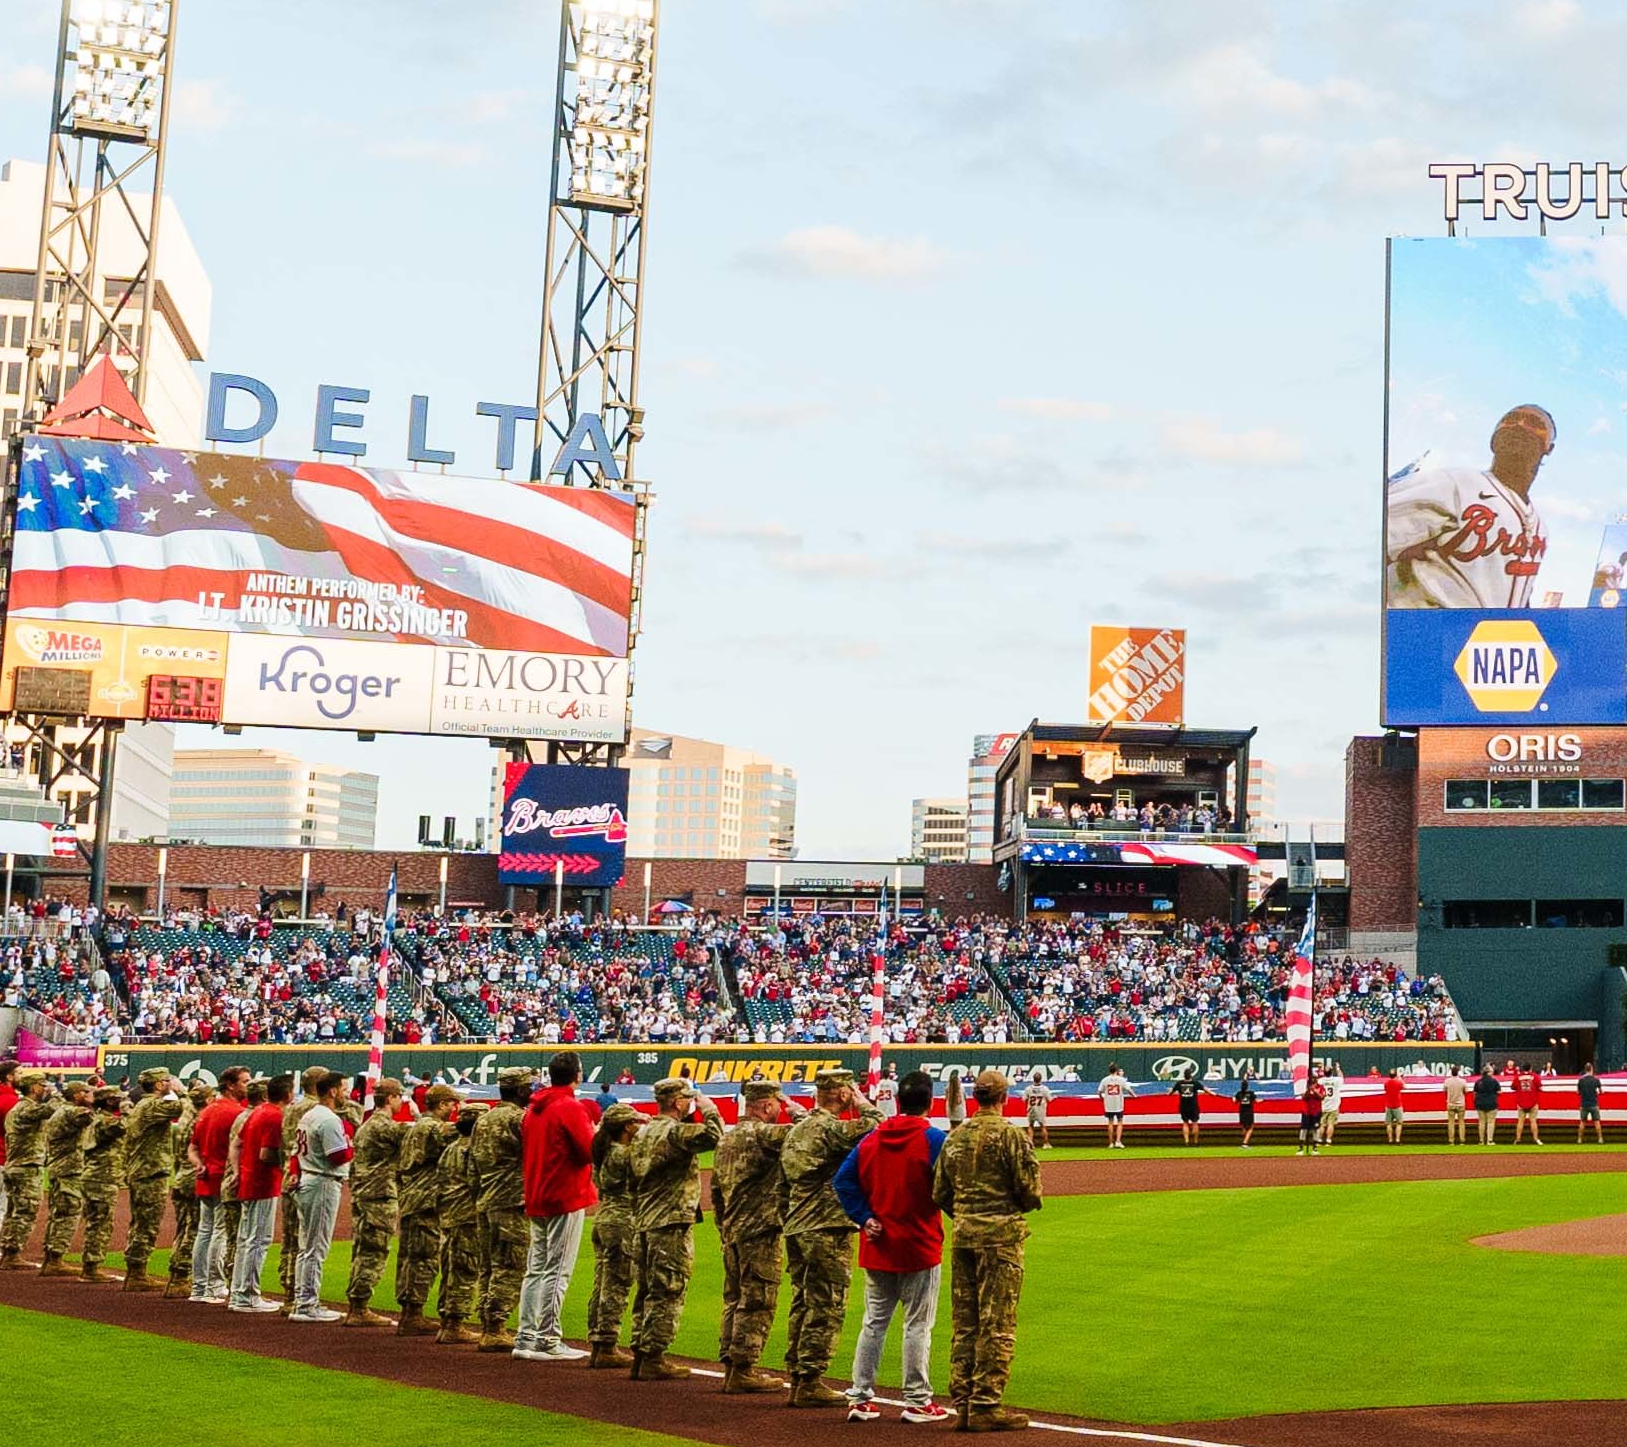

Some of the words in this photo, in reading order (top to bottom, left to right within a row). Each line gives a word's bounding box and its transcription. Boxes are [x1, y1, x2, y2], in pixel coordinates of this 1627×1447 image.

[205, 372, 622, 481] DELTA
[246, 573, 307, 596] ANTHEM
[312, 578, 396, 603] PERFORMED
[401, 586, 425, 604] BY:
[198, 591, 230, 622] LT.
[239, 595, 329, 628] KRISTIN
[337, 603, 468, 638] GRISSINGER
[45, 631, 102, 652] MEGA
[142, 648, 203, 659] POWER
[41, 651, 102, 662] MILLIONS
[1099, 637, 1139, 674] THE
[1473, 648, 1540, 684] NAPA
[259, 645, 401, 719] Kroger
[445, 651, 619, 695] EMORY
[1089, 629, 1183, 721] HOME
[151, 676, 222, 705] 638
[1126, 664, 1184, 722] DEPOT
[149, 705, 219, 721] MILLION
[444, 695, 609, 721] HEALTHCARE
[442, 722, 479, 733] Official
[482, 724, 509, 735] Team
[513, 726, 567, 736] Healthcare
[571, 729, 613, 741] Provider
[1487, 734, 1582, 761] ORIS
[1115, 758, 1182, 773] CLUBHOUSE
[504, 798, 610, 836] Braves
[1094, 882, 1146, 893] SLICE
[105, 1054, 129, 1067] 375
[638, 1053, 658, 1064] 385
[876, 1089, 891, 1101] 23
[1029, 1096, 1043, 1107] 27
[1107, 1084, 1120, 1096] 23
